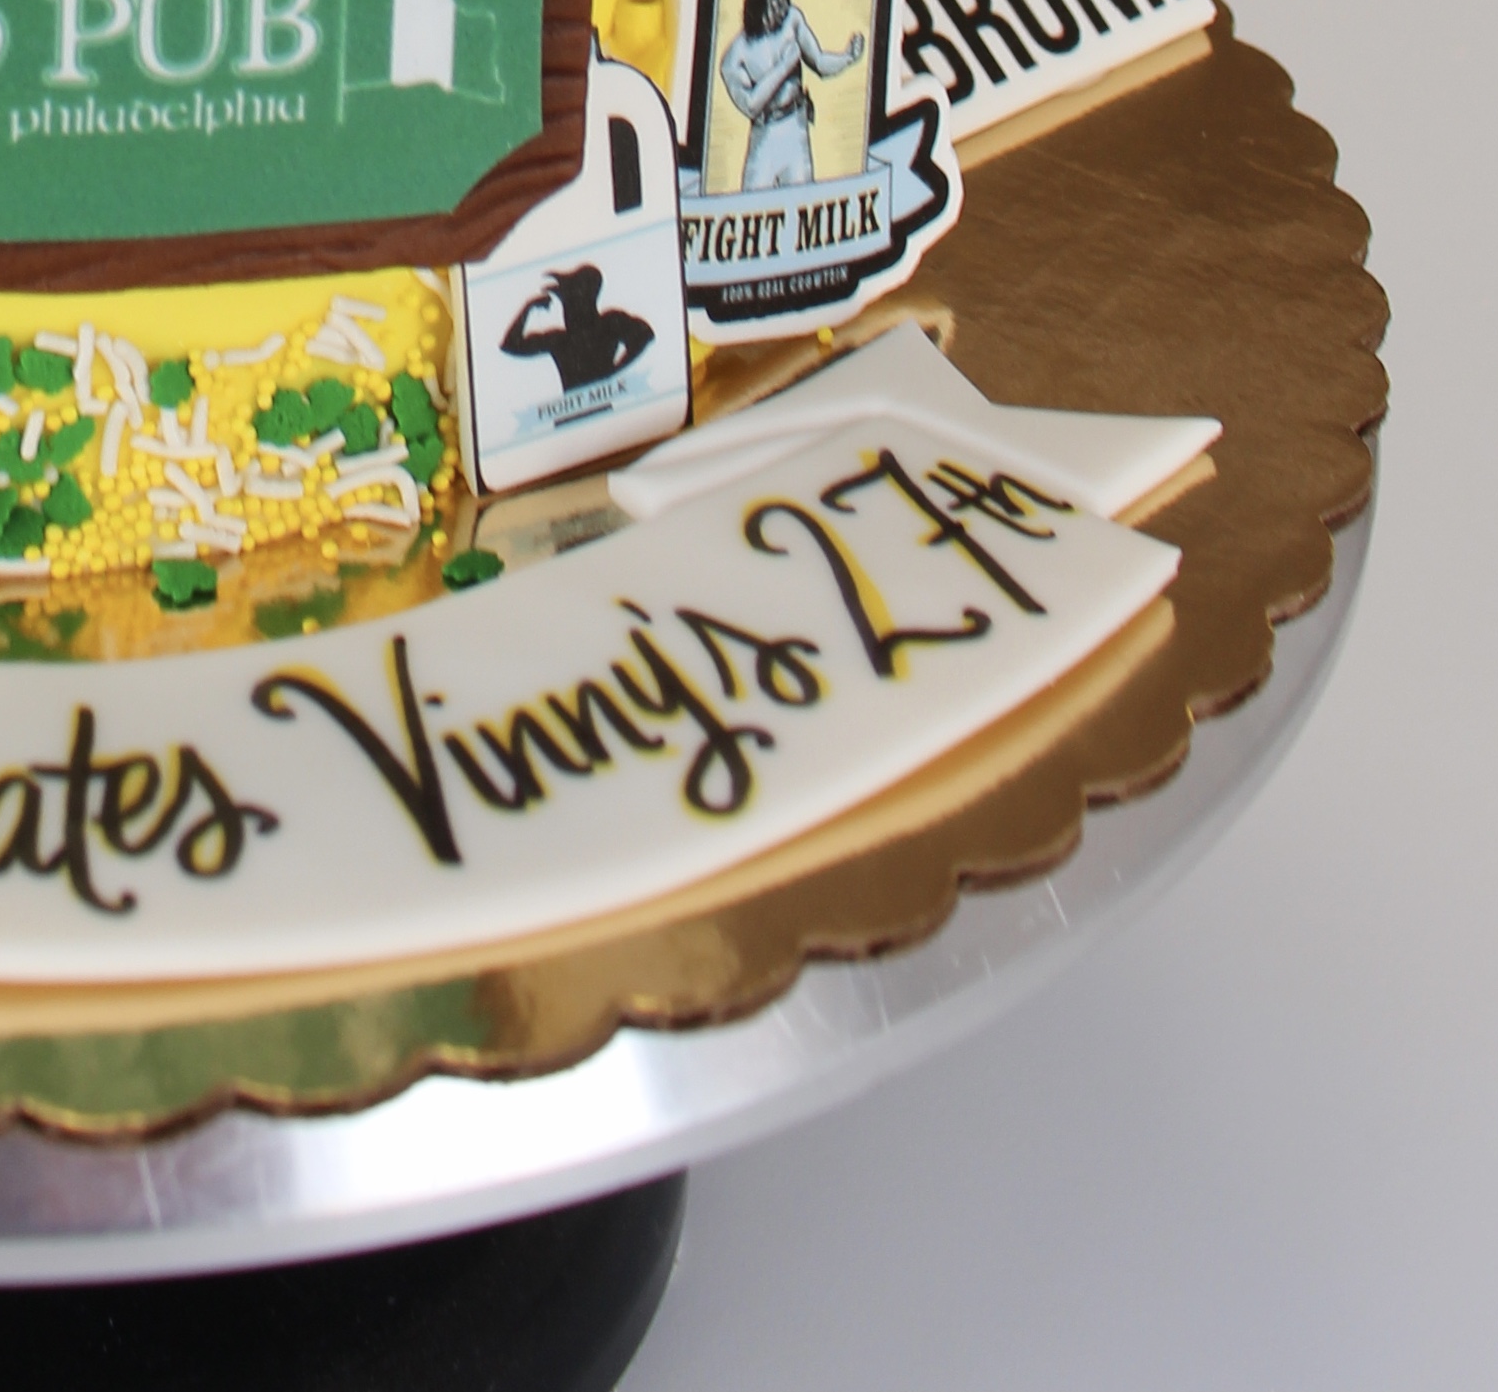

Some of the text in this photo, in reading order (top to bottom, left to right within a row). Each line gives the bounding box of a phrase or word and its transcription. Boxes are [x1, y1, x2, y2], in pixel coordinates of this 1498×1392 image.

[682, 188, 880, 262] FIGHT MILK
[537, 380, 628, 420] FIGHT MILK
[250, 597, 821, 866] Vinny's
[742, 445, 1082, 680] 27th
